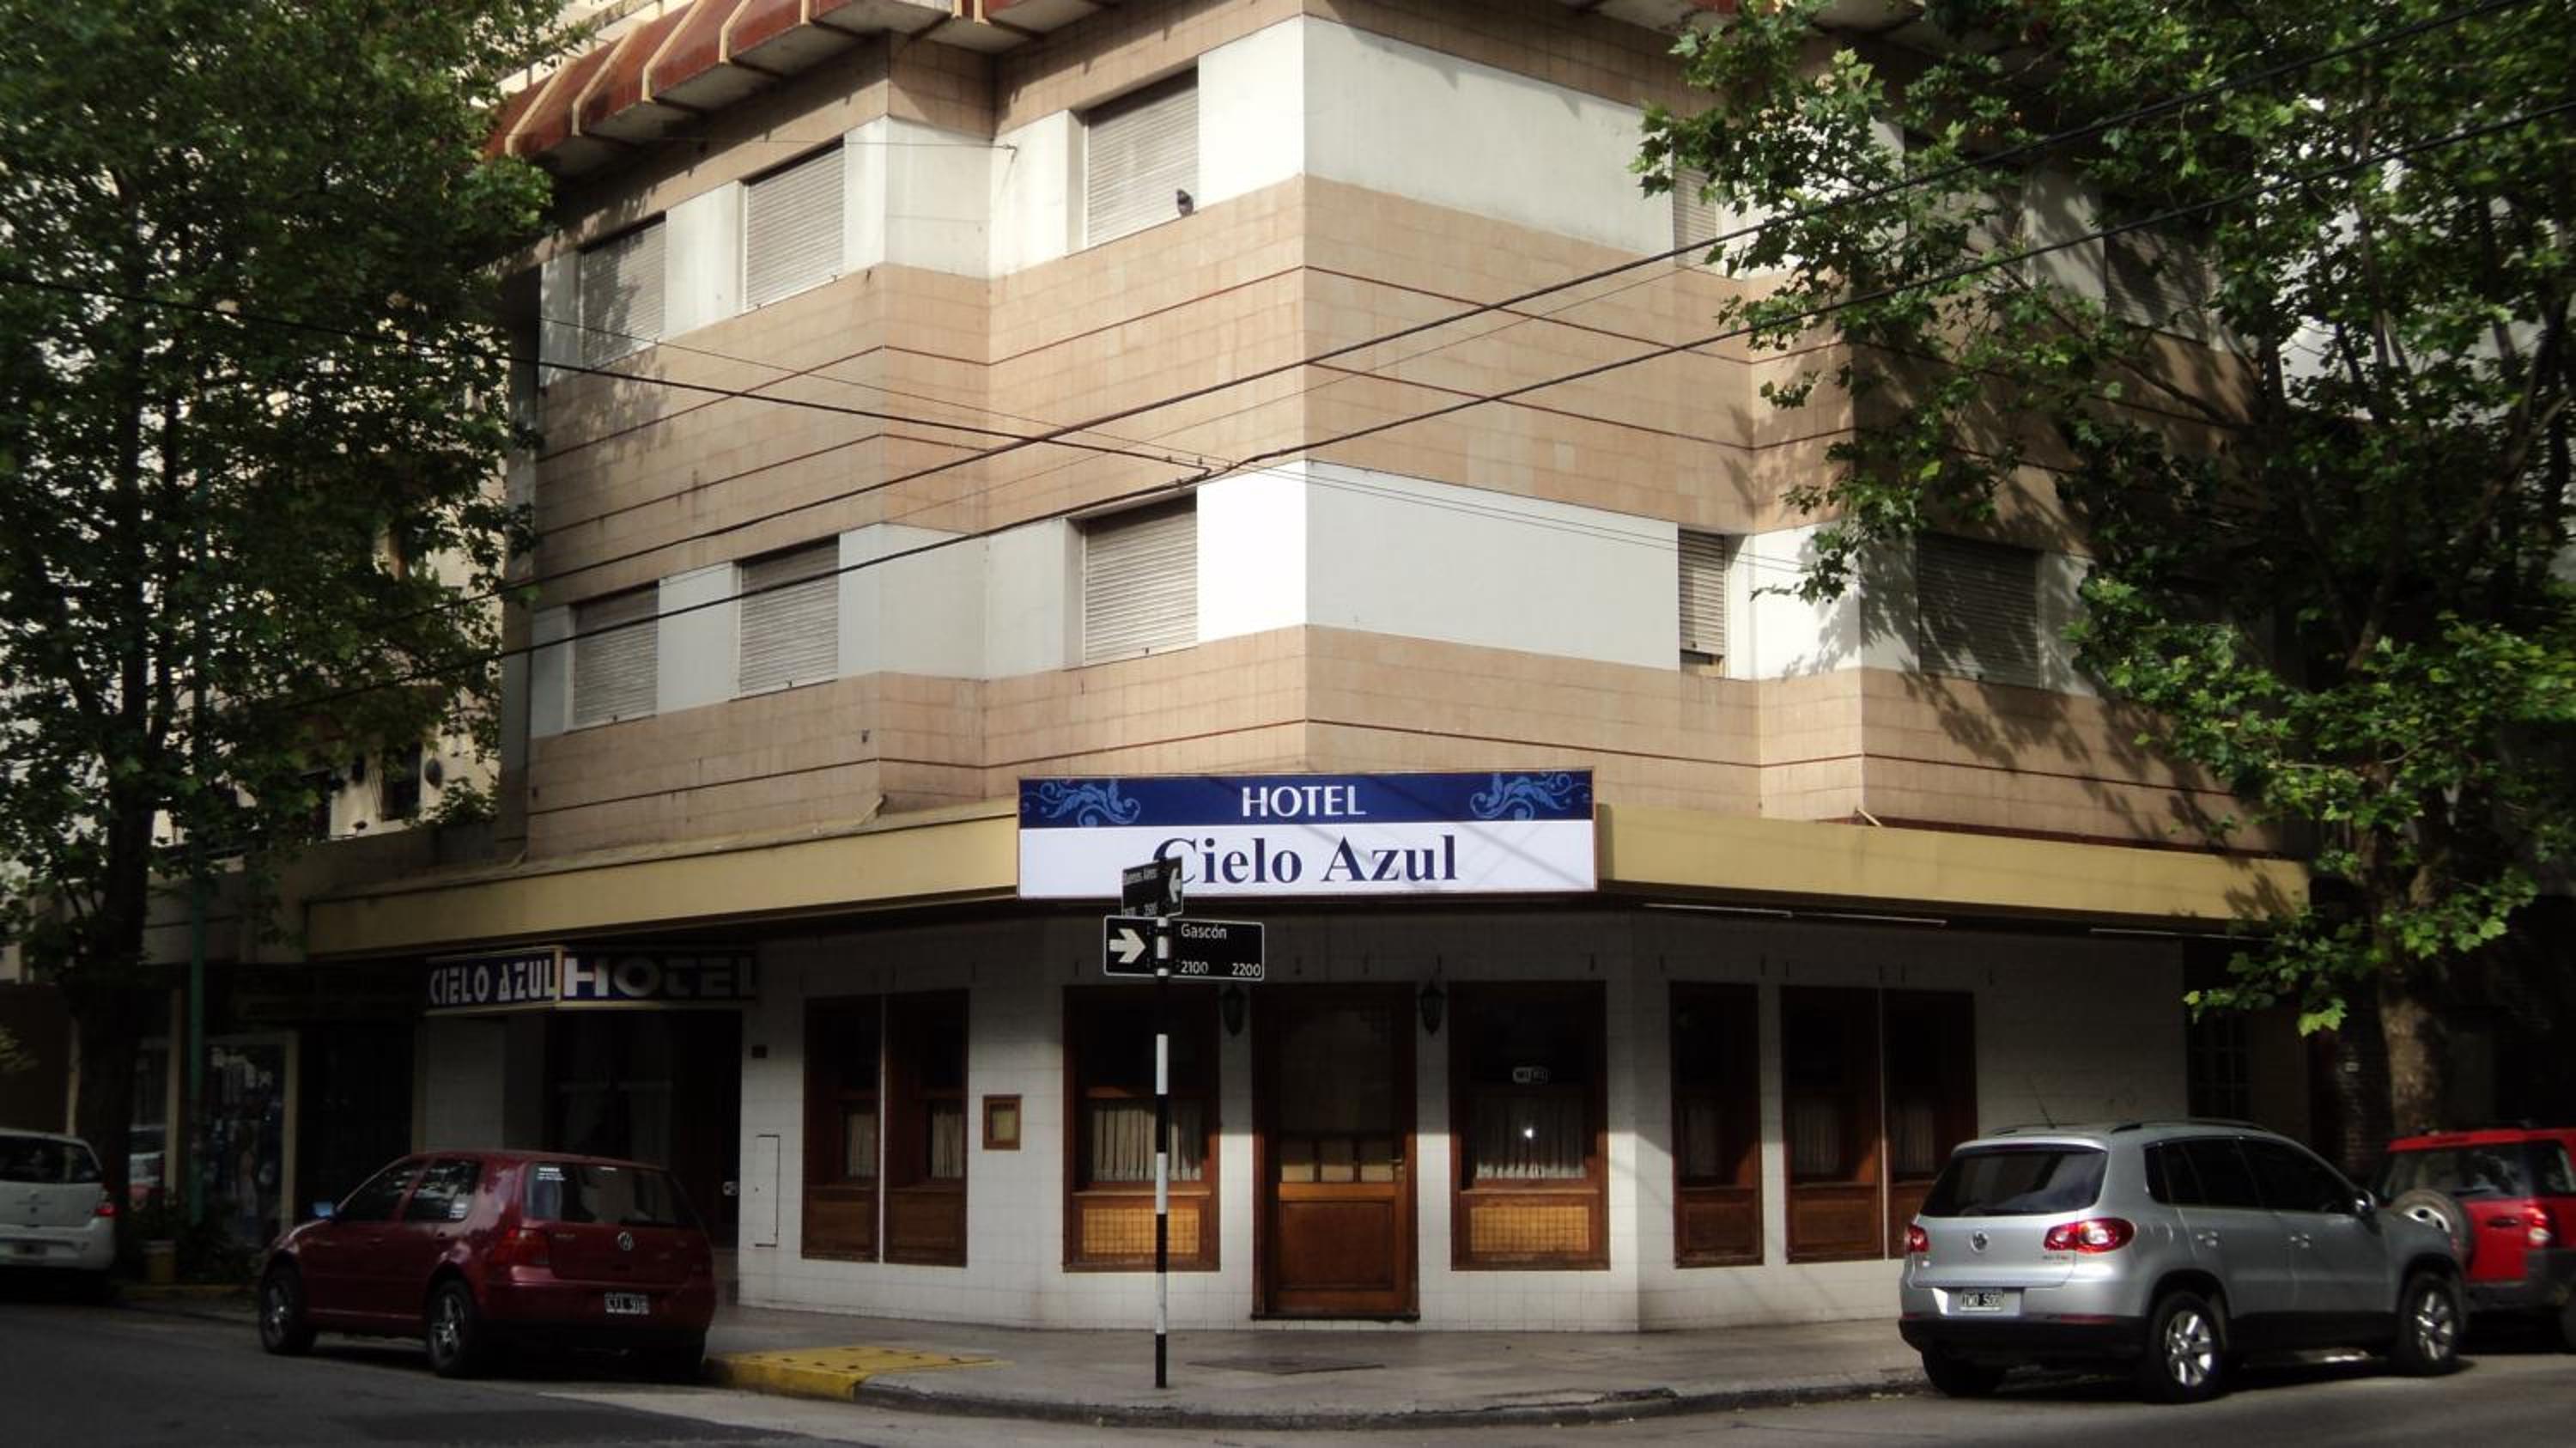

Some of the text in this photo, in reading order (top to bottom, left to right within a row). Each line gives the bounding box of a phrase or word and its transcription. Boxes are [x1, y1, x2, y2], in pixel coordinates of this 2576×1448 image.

[1242, 785, 1367, 817] HOTEL
[1152, 834, 1458, 885] Cielo Azul
[1180, 922, 1228, 940] Gascón
[428, 957, 556, 1005] CIELO AZUL
[563, 956, 756, 997] HOTEL
[1180, 960, 1262, 977] 2100 2200
